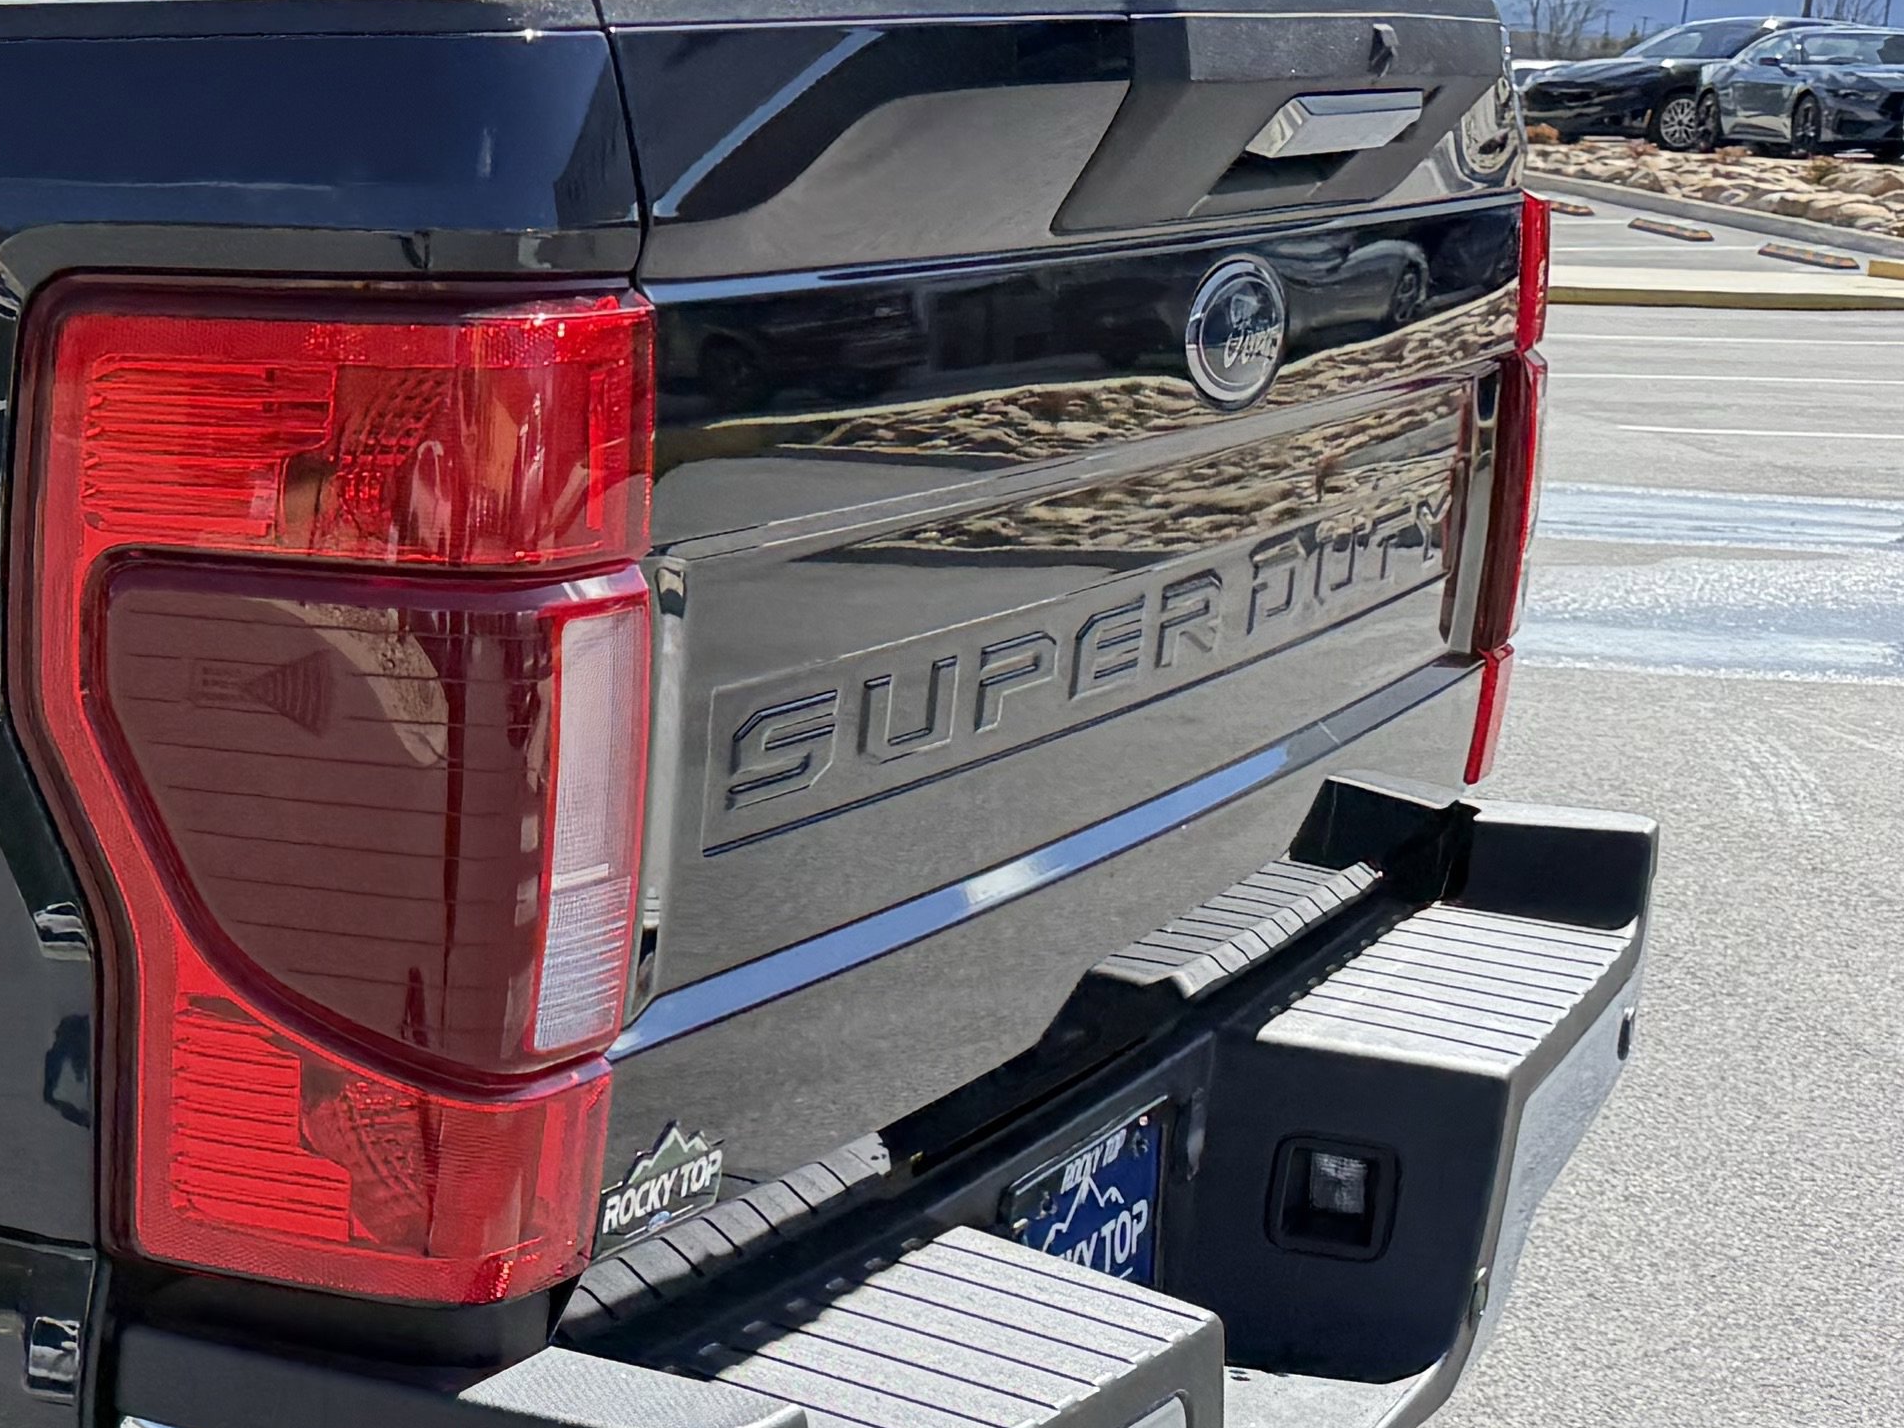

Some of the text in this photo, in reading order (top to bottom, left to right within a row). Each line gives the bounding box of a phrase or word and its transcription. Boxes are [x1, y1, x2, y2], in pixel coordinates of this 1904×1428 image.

[725, 567, 1224, 812] SUPER
[602, 1149, 723, 1234] ROCKY TOP
[1100, 1199, 1149, 1273] TOP
